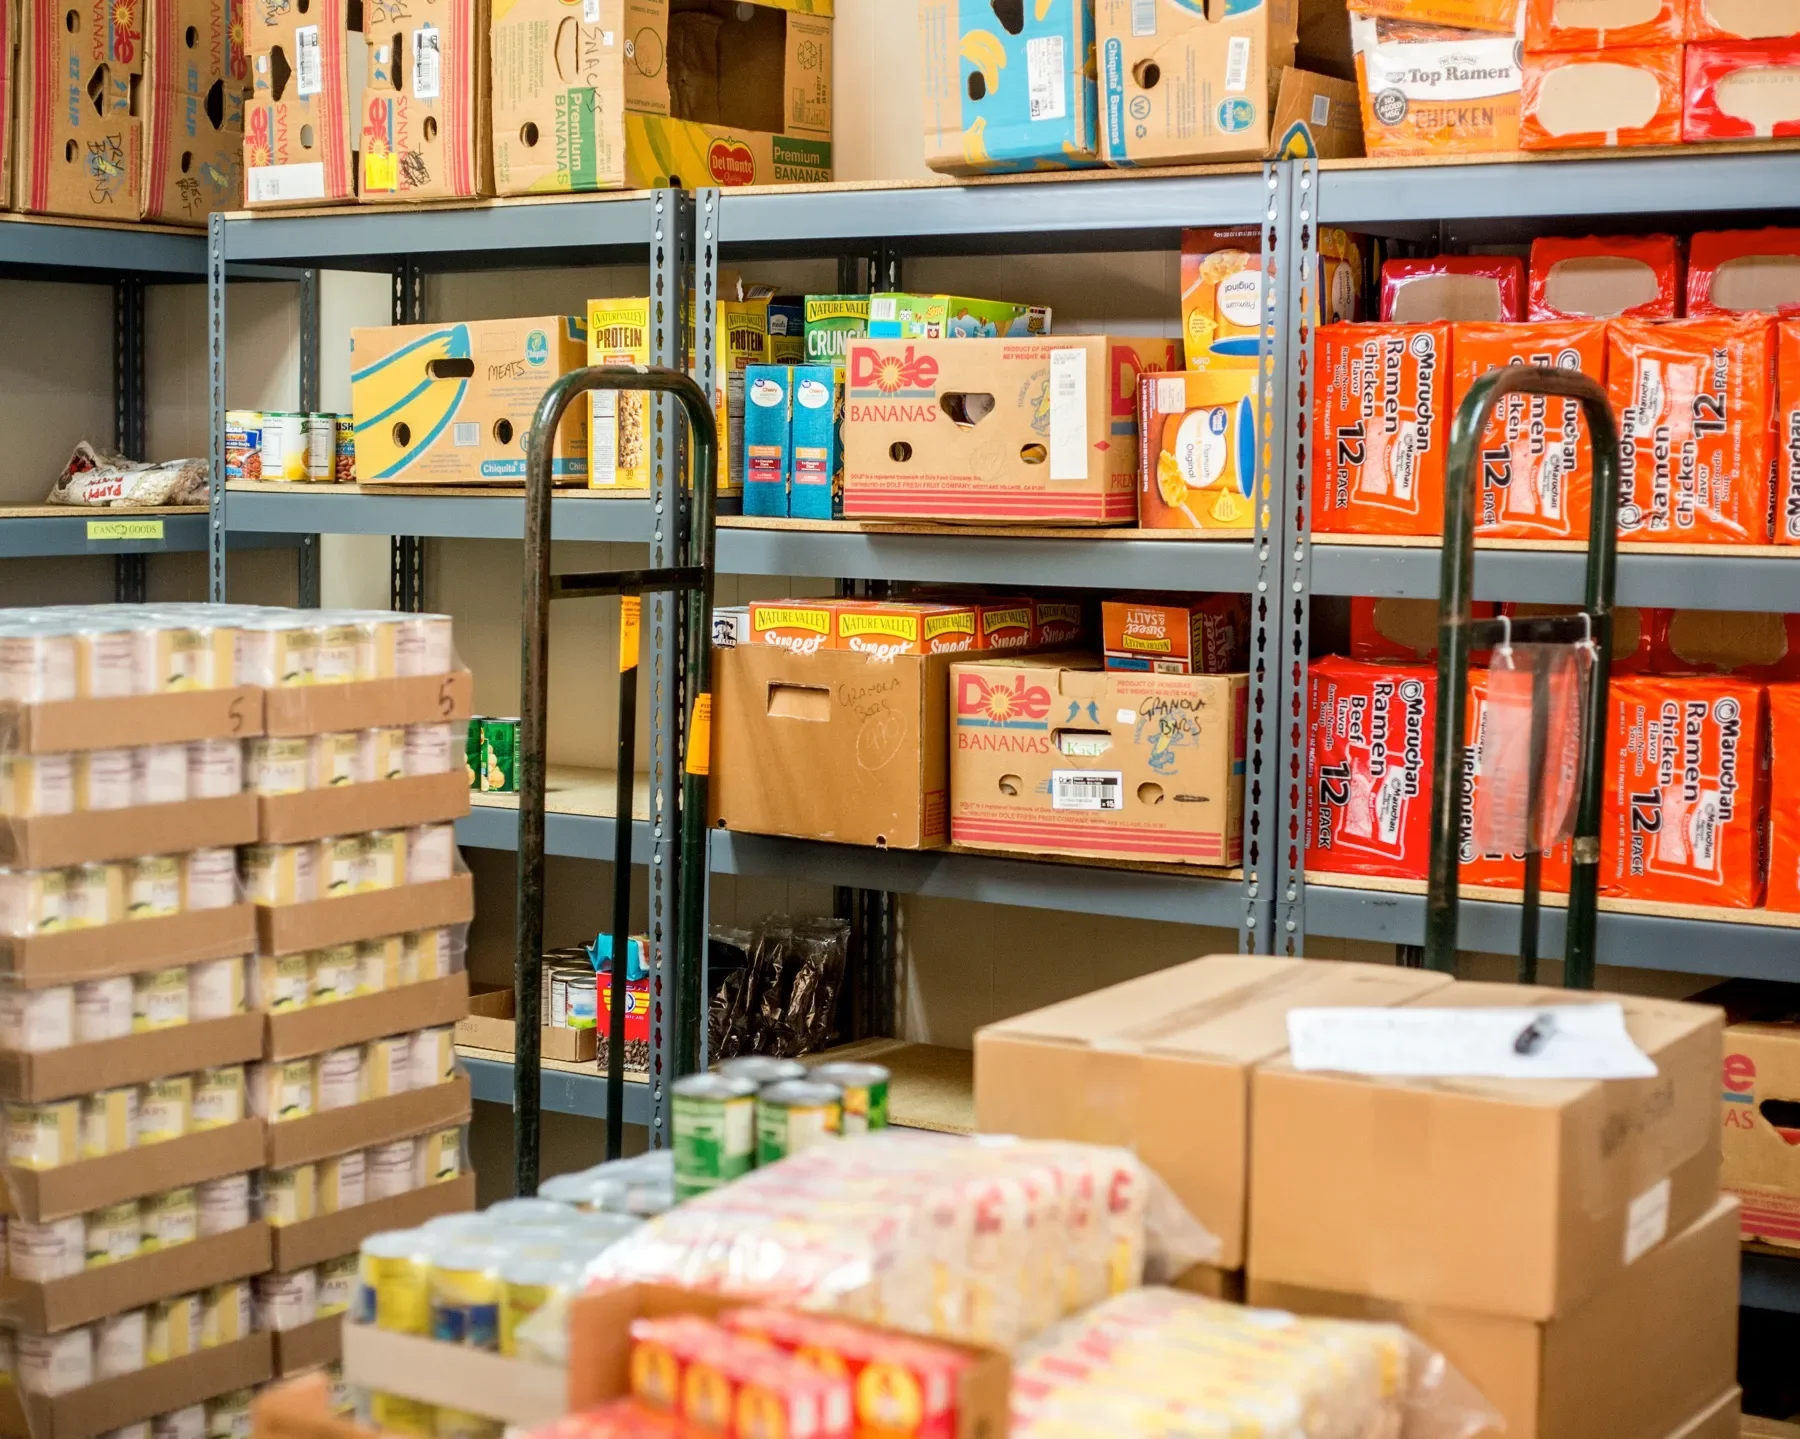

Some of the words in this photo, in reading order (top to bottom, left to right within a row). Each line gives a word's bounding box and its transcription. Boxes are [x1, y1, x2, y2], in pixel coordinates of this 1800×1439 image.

[92, 0, 104, 60] NANAS
[113, 0, 142, 64] ole
[210, 0, 222, 76] ANANAS
[70, 55, 80, 81] EZ
[580, 27, 605, 113] SNACKS
[1106, 40, 1118, 89] Chiquita
[1408, 68, 1442, 86] Top
[1446, 66, 1511, 82] Ramen
[69, 84, 80, 128] SLIP
[1134, 100, 1144, 114] W
[1380, 103, 1402, 113] ADDED
[1384, 96, 1395, 104] NO
[1385, 110, 1400, 118] MSG
[1415, 107, 1494, 128] CHICKEN
[246, 106, 268, 167] ole
[276, 104, 288, 164] NANAS
[570, 92, 582, 170] Premium
[1110, 94, 1120, 145] Bananas
[106, 132, 125, 176] DRY
[396, 96, 410, 192] BANANAS
[555, 94, 568, 185] BANANAS
[774, 146, 821, 165] Premium
[87, 140, 113, 204] BEANS
[712, 155, 726, 169] Del
[726, 157, 752, 173] Monte
[775, 166, 829, 184] BANANAS
[1225, 282, 1256, 294] Original
[595, 312, 619, 324] NATURE
[619, 312, 643, 324] VALLEY
[809, 302, 844, 316] NATURE
[845, 300, 870, 314] VALLE
[596, 328, 642, 348] PROTEIN
[730, 330, 764, 352] PROTEIN
[808, 330, 868, 356] CRUN
[488, 358, 526, 380] MEATS
[851, 346, 939, 391] Dole
[1333, 364, 1341, 387] Soup
[1341, 346, 1349, 375] Ramen
[1352, 360, 1362, 396] Flavor
[1363, 341, 1378, 418] Chicken
[1385, 340, 1404, 433] Ramen
[1416, 353, 1435, 452] Maruchan
[1531, 356, 1550, 454] Rmen
[1638, 370, 1650, 416] Maruchan
[1692, 393, 1726, 438] 12
[1714, 348, 1727, 388] PACK
[851, 405, 936, 423] BANANAS
[1184, 444, 1194, 478] Original
[1338, 420, 1366, 466] 12
[1618, 408, 1636, 506] Maruchan
[483, 463, 516, 474] Chiquita
[1402, 444, 1414, 488] Maruchan
[1484, 444, 1511, 490] 12
[1650, 426, 1669, 529] Ramen
[1676, 440, 1694, 526] Chicken
[1713, 450, 1722, 486] Noodle
[1786, 412, 1800, 516] Maruchan
[1336, 470, 1348, 508] PACK
[1550, 464, 1559, 508] Maruchan
[1698, 464, 1708, 505] Flavor
[1721, 474, 1730, 500] Soup
[1767, 460, 1776, 526] Maruchan
[1484, 494, 1495, 526] PACK
[1712, 488, 1722, 521] Ramen
[94, 524, 127, 535] CANN
[128, 525, 156, 534] GOODS
[758, 610, 794, 627] NATURE
[794, 611, 828, 632] VALLEY
[842, 616, 878, 632] NATURE
[879, 617, 914, 639] VALLEY
[926, 616, 950, 634] NATURE
[950, 613, 974, 633] VALLEY
[985, 611, 1007, 632] NATURE
[1008, 609, 1030, 628] VALLEY
[1124, 624, 1166, 638] Sweet
[1126, 612, 1158, 625] SALTY
[765, 630, 827, 654] Sweet
[850, 636, 914, 659] Sweet
[1124, 638, 1146, 648] VALLEY
[1146, 641, 1170, 652] NATURE
[1204, 614, 1217, 672] weet
[438, 678, 455, 716] 5
[838, 678, 900, 708] GRANOLA
[958, 674, 1052, 722] Dole
[1116, 680, 1146, 688] PRODUCT
[1327, 684, 1335, 714] Ramen
[228, 696, 244, 732] 5
[1160, 716, 1202, 736] BARS
[1326, 715, 1334, 750] Noodle
[1338, 698, 1348, 737] Flavor
[1350, 696, 1365, 744] Beef
[1371, 684, 1392, 777] Ramen
[1636, 706, 1644, 739] Ramen
[958, 733, 1050, 754] BANANAS
[1404, 699, 1424, 796] Maruchan
[1628, 726, 1636, 752] Soup
[1648, 722, 1660, 762] Flavor
[1661, 702, 1678, 785] Chicken
[1684, 703, 1706, 802] Ramen
[1636, 741, 1644, 776] Noodle
[1718, 720, 1738, 820] Maruchan
[1320, 762, 1351, 806] 12
[1459, 747, 1475, 840] Maruchan
[1318, 808, 1332, 848] PACK
[1388, 788, 1401, 832] Maruchan
[1632, 788, 1662, 834] 12
[1704, 814, 1715, 858] Maruchan
[1631, 836, 1643, 876] PACK
